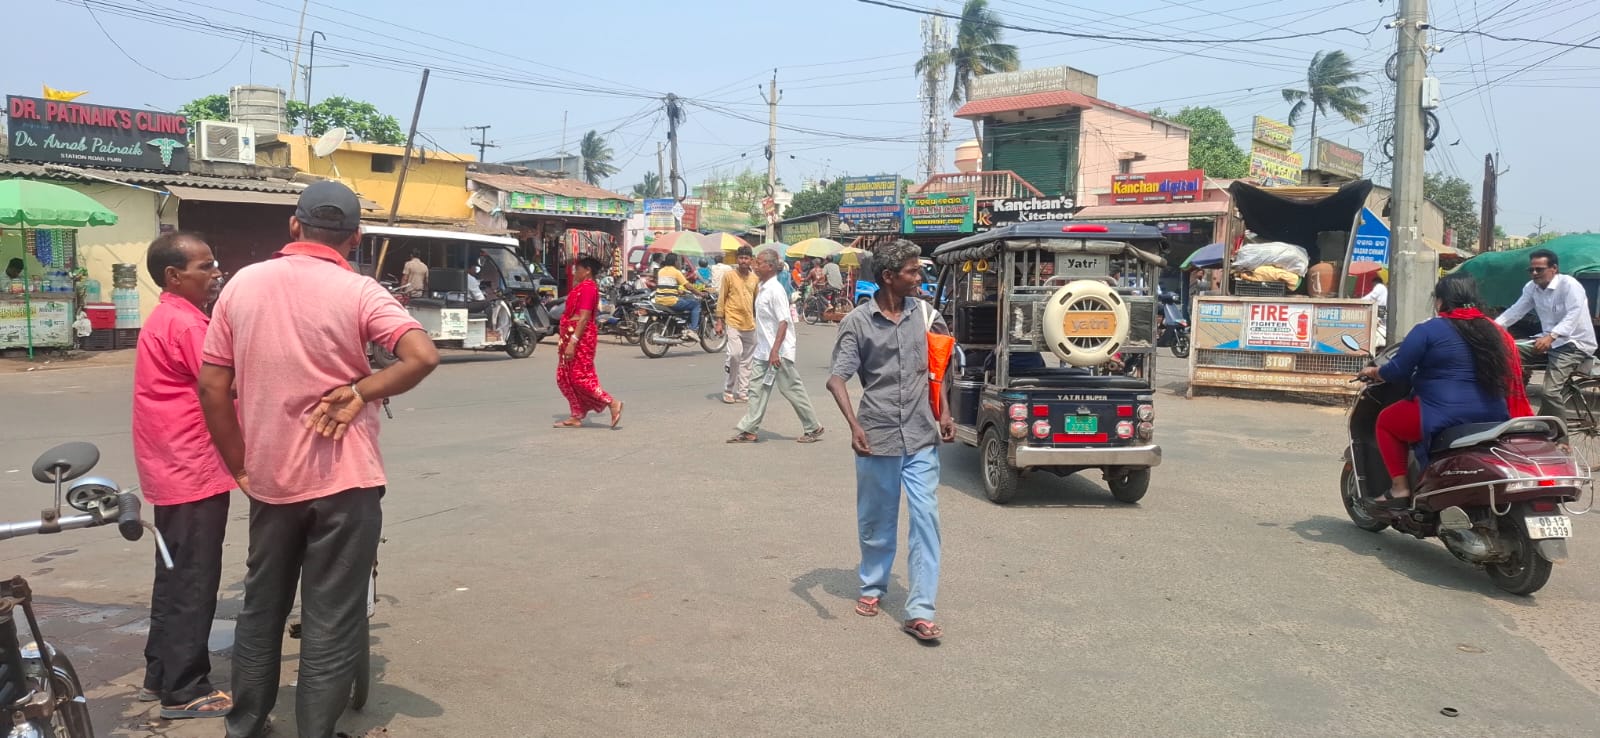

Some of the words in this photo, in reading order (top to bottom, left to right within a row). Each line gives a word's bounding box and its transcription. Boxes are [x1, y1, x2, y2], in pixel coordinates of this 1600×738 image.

[10, 97, 40, 120] DR.
[46, 101, 132, 129] PATNAIK'S
[135, 111, 186, 135] CLINIC
[15, 130, 37, 147] Dr.
[43, 133, 88, 151] Arnab
[91, 137, 143, 155] Patnaik
[1113, 180, 1160, 194] Kanchan
[1160, 177, 1199, 195] digital
[906, 206, 943, 215] HEALTH
[944, 204, 970, 214] CARE
[993, 195, 1074, 212] Kanchan's
[1018, 211, 1073, 222] Kitchen
[1250, 304, 1289, 321] FIRE
[1318, 308, 1339, 319] SUPER
[1265, 357, 1291, 368] STOP
